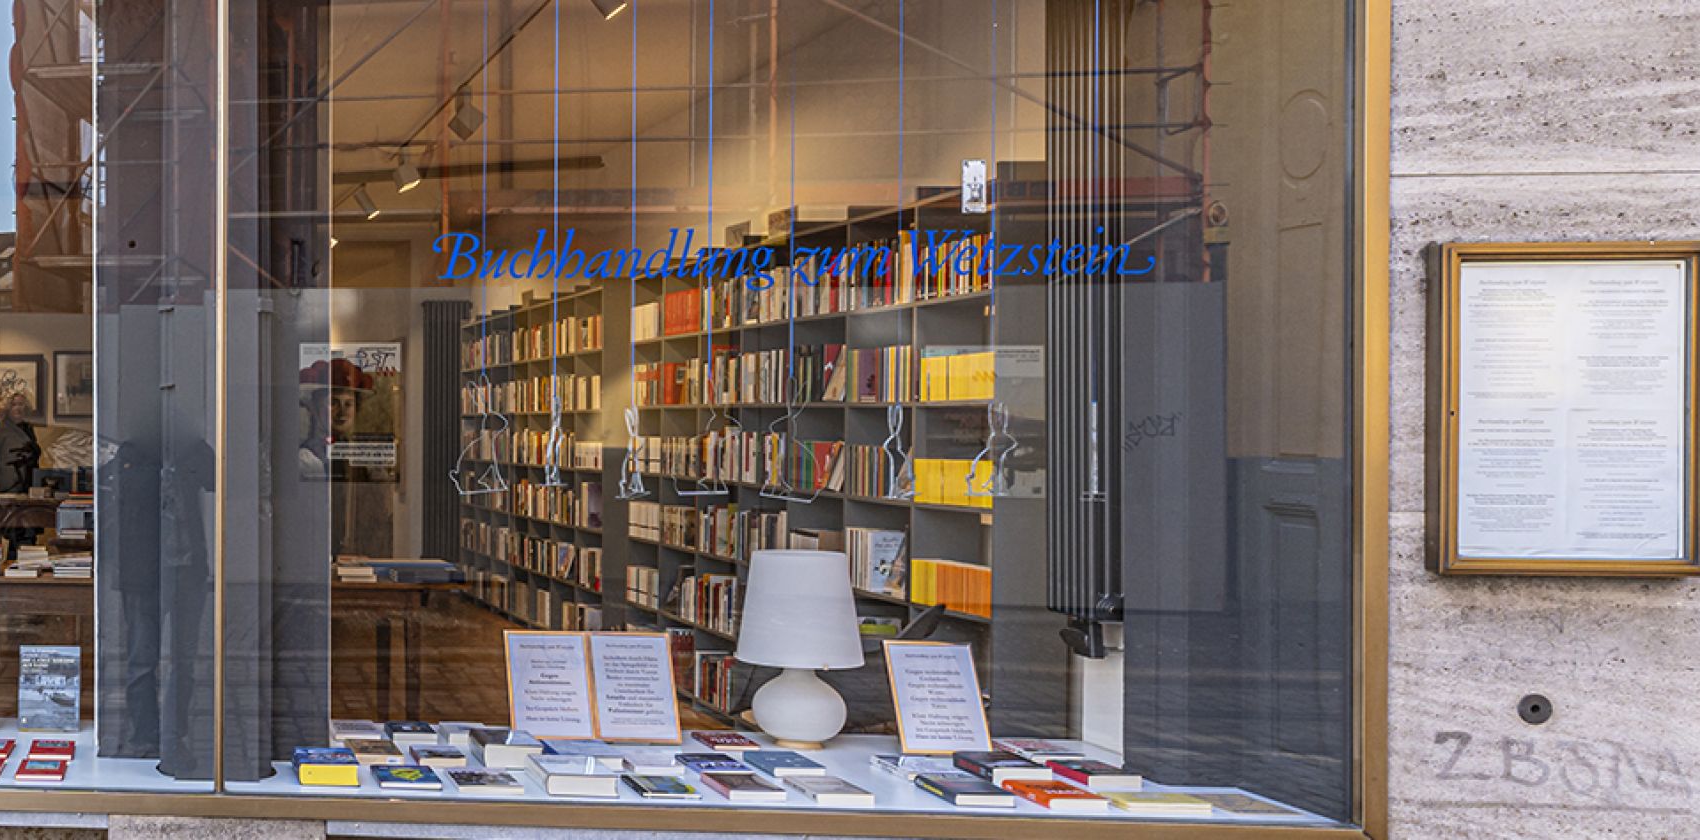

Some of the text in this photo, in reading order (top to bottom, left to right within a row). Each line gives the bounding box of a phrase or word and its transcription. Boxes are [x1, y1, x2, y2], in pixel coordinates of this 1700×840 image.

[432, 225, 1155, 292] Buchhandlung zum Wetzstein
